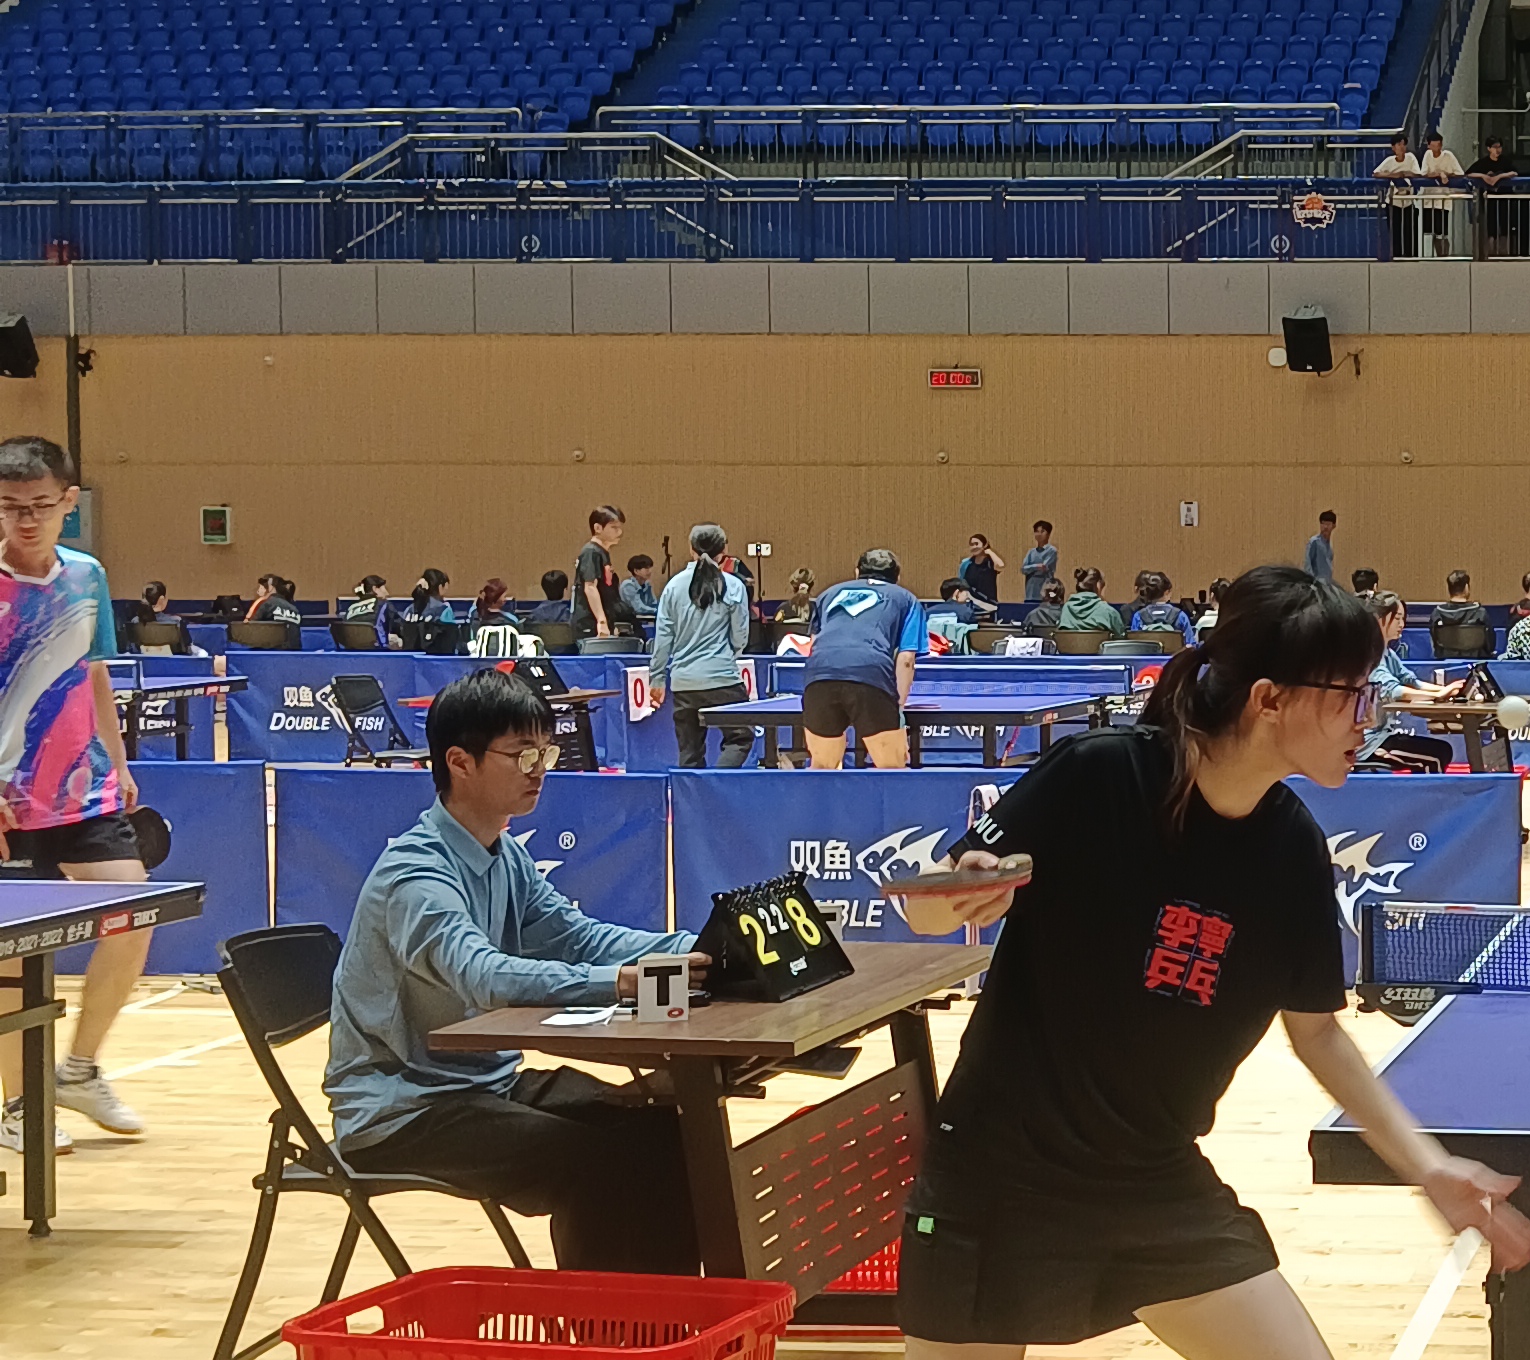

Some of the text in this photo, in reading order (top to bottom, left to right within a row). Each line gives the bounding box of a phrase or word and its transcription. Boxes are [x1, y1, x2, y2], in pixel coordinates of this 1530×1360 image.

[269, 712, 384, 731] DOUBLE FISH
[738, 913, 780, 966] 2
[785, 897, 821, 946] 8
[644, 965, 682, 1006] T
